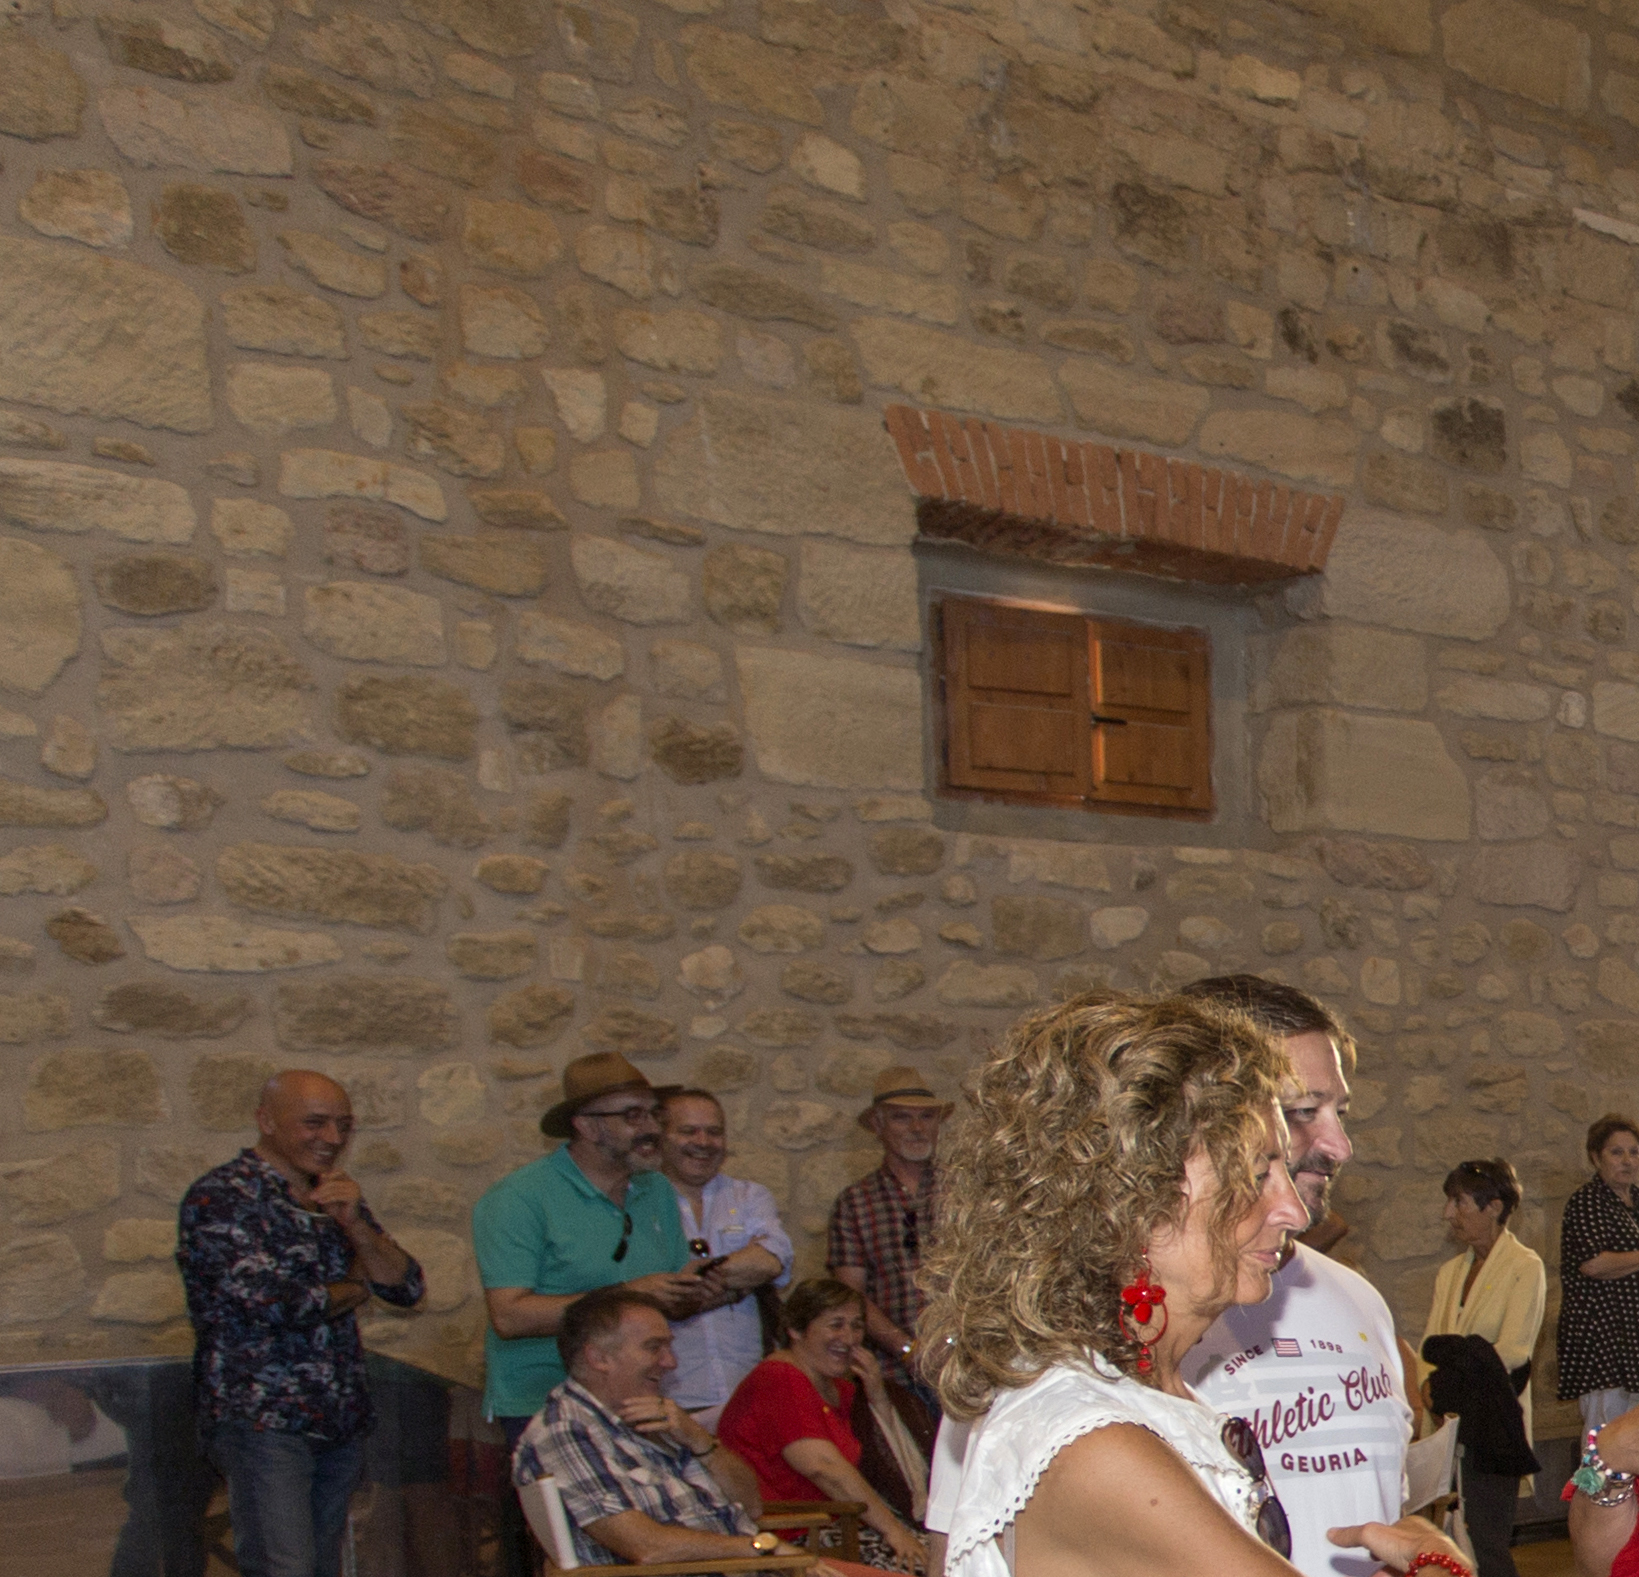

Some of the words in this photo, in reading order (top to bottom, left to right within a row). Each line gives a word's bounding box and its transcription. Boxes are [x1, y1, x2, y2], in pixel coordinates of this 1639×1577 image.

[1224, 1345, 1264, 1376] SINCE
[1310, 1339, 1343, 1354] 1898
[1337, 1363, 1393, 1411] Club
[1281, 1448, 1368, 1473] GEURIA
